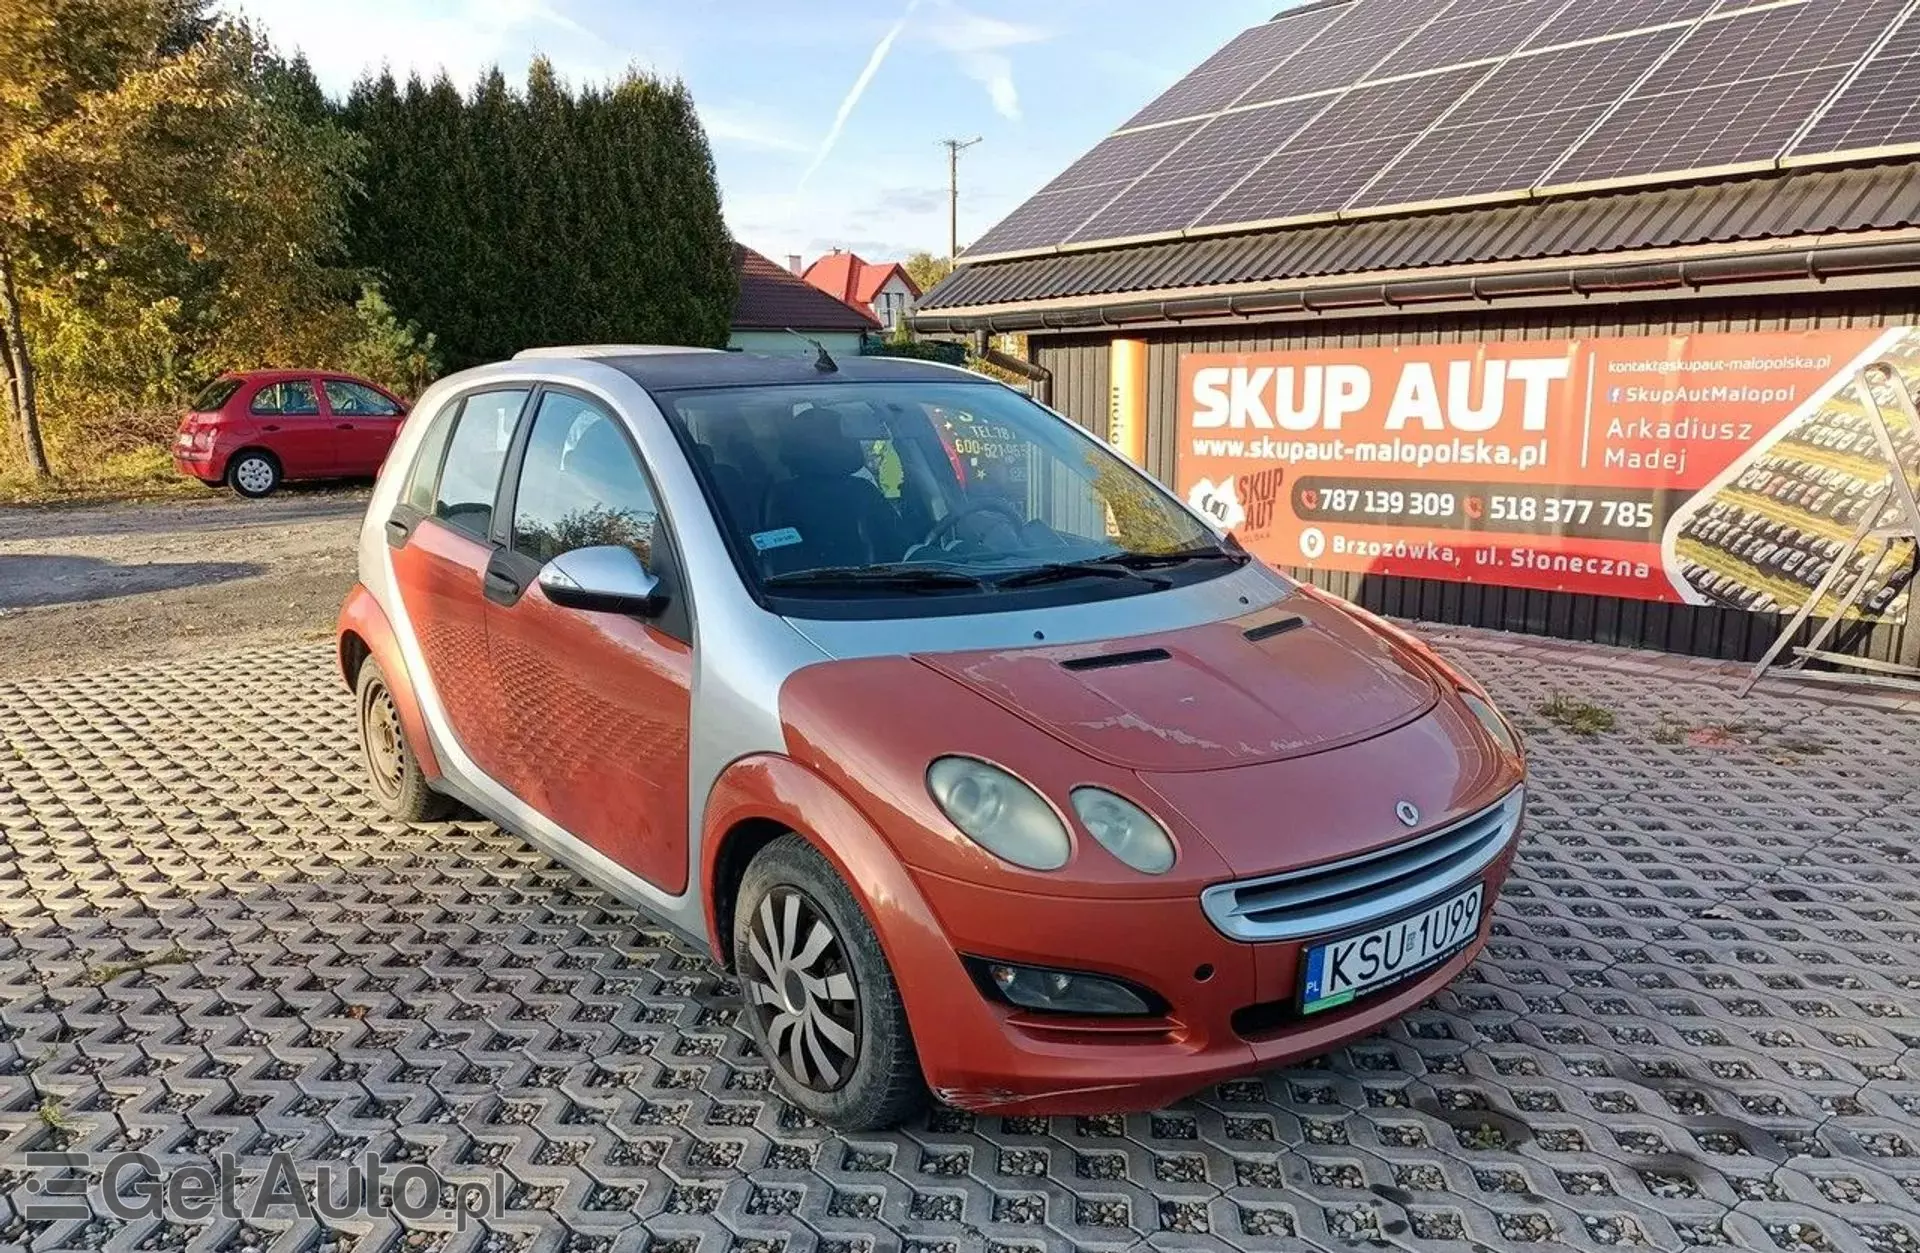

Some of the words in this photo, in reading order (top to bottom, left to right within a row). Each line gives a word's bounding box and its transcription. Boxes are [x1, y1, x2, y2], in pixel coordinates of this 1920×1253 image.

[1608, 354, 1831, 375] kontakt@skupaut-malopolska.pl
[1192, 364, 1372, 431] SKUP
[1384, 357, 1569, 431] AUT
[1626, 385, 1796, 405] SkupAutMalopol
[1606, 417, 1753, 441] Arkadiusz
[1193, 437, 1547, 469] www.skupaut-malopolska.pl
[1604, 448, 1687, 476] Madej
[1239, 467, 1283, 505] SKUP
[1320, 488, 1359, 511] 787
[1364, 490, 1404, 514] 139
[1408, 492, 1455, 516] 309
[1244, 500, 1275, 532] AUT
[1490, 496, 1537, 521] 518
[1544, 498, 1593, 524] 377
[1601, 501, 1653, 528] 785
[1333, 535, 1460, 567] Brzozówka,
[1475, 546, 1504, 566] ul.
[1511, 547, 1650, 578] Słoneczna
[1329, 925, 1407, 992] KSU
[1419, 892, 1478, 956] 1U99
[1305, 980, 1320, 994] PL
